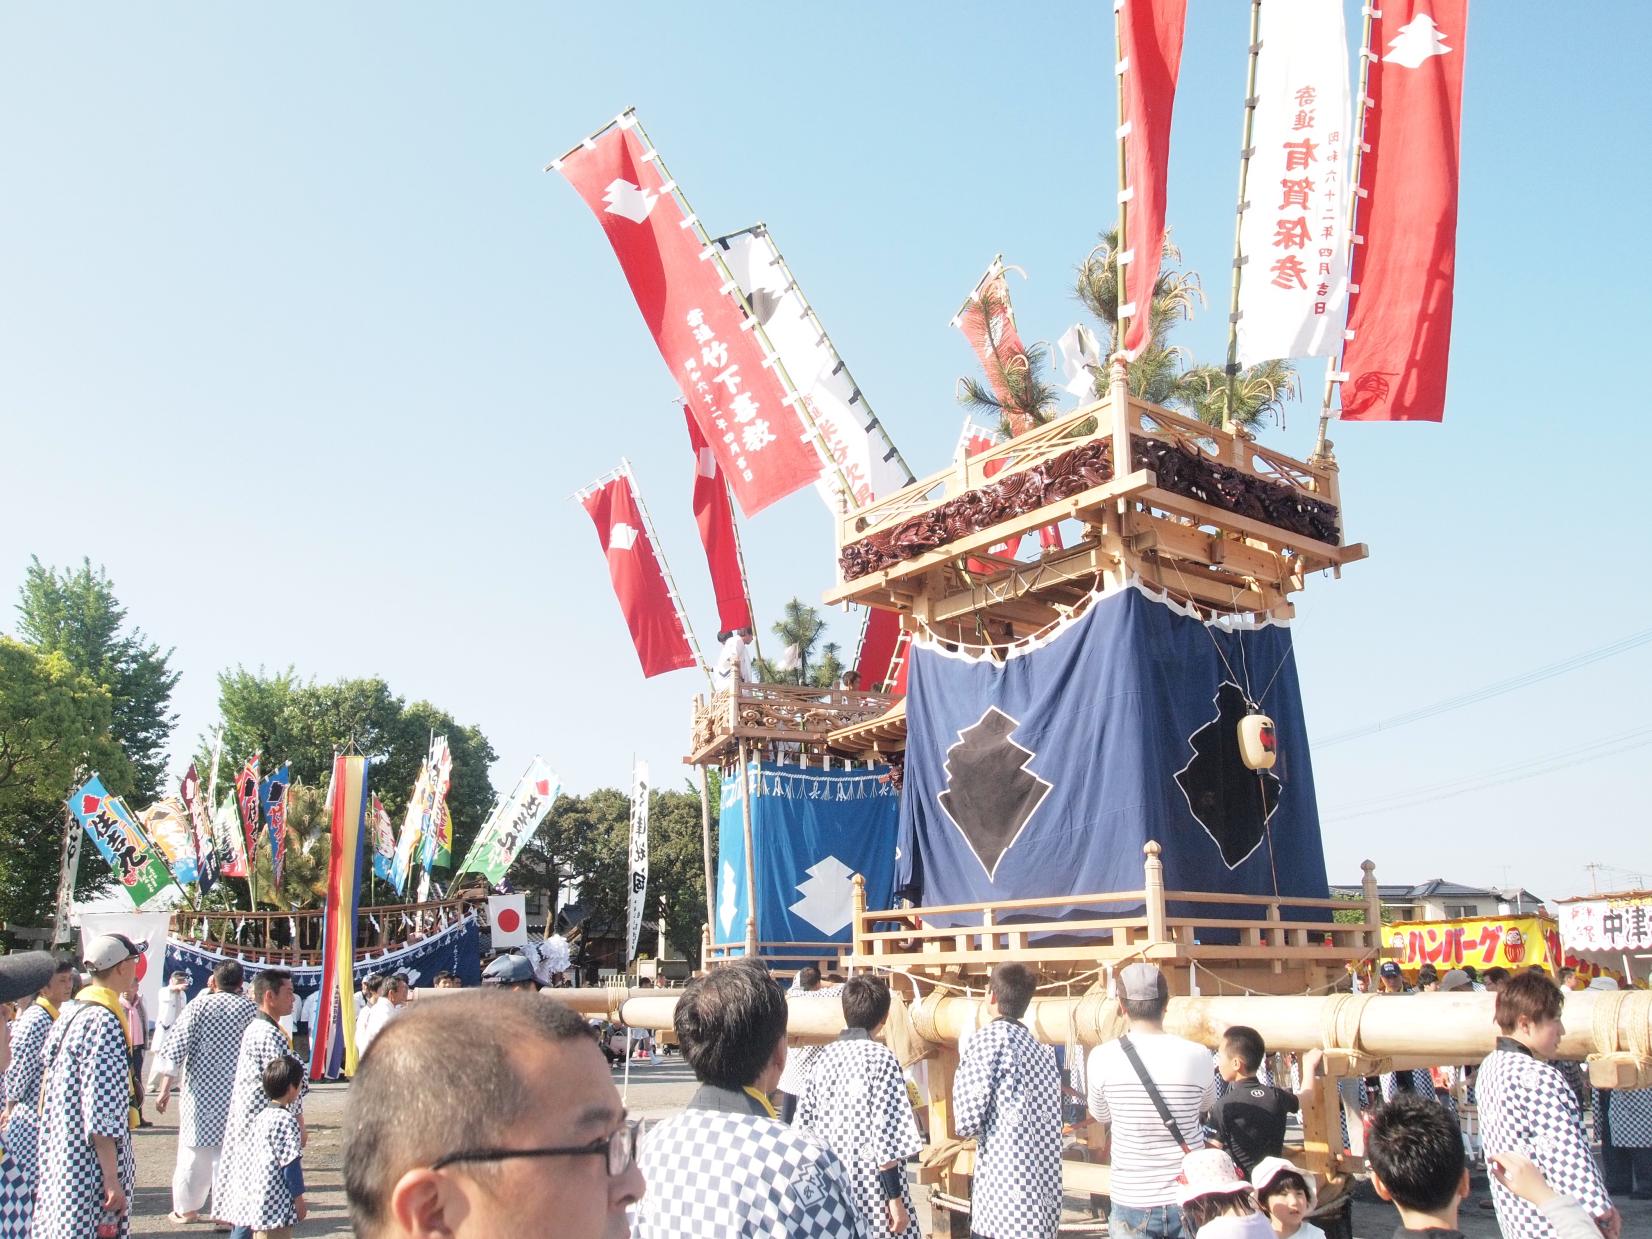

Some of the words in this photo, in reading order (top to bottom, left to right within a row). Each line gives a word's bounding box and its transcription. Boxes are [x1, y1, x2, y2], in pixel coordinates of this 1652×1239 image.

[91, 810, 148, 877] 住吉丸
[1407, 924, 1503, 964] ハンバーグ
[1603, 906, 1652, 944] 中津
